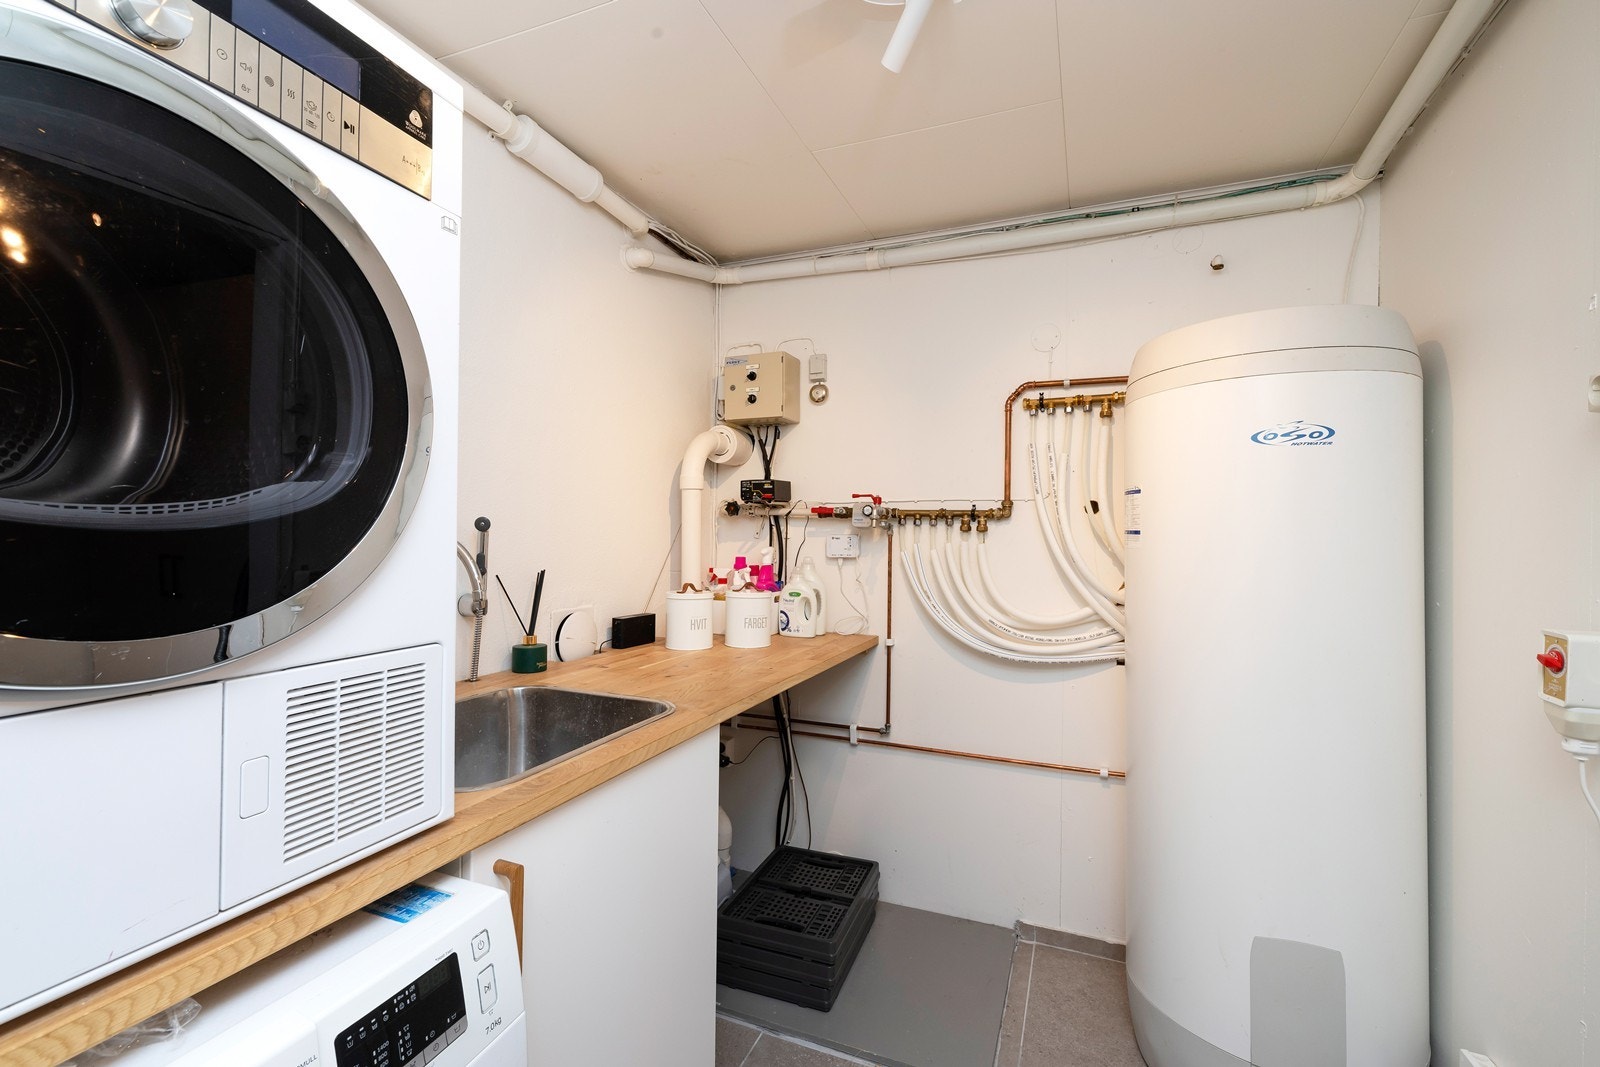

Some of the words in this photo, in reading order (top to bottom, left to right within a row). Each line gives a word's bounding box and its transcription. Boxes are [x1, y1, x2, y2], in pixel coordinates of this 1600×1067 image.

[690, 618, 707, 630] HVIT
[743, 616, 767, 629] FARGET
[485, 1017, 502, 1035] 7.0kg
[377, 1040, 389, 1053] 1400
